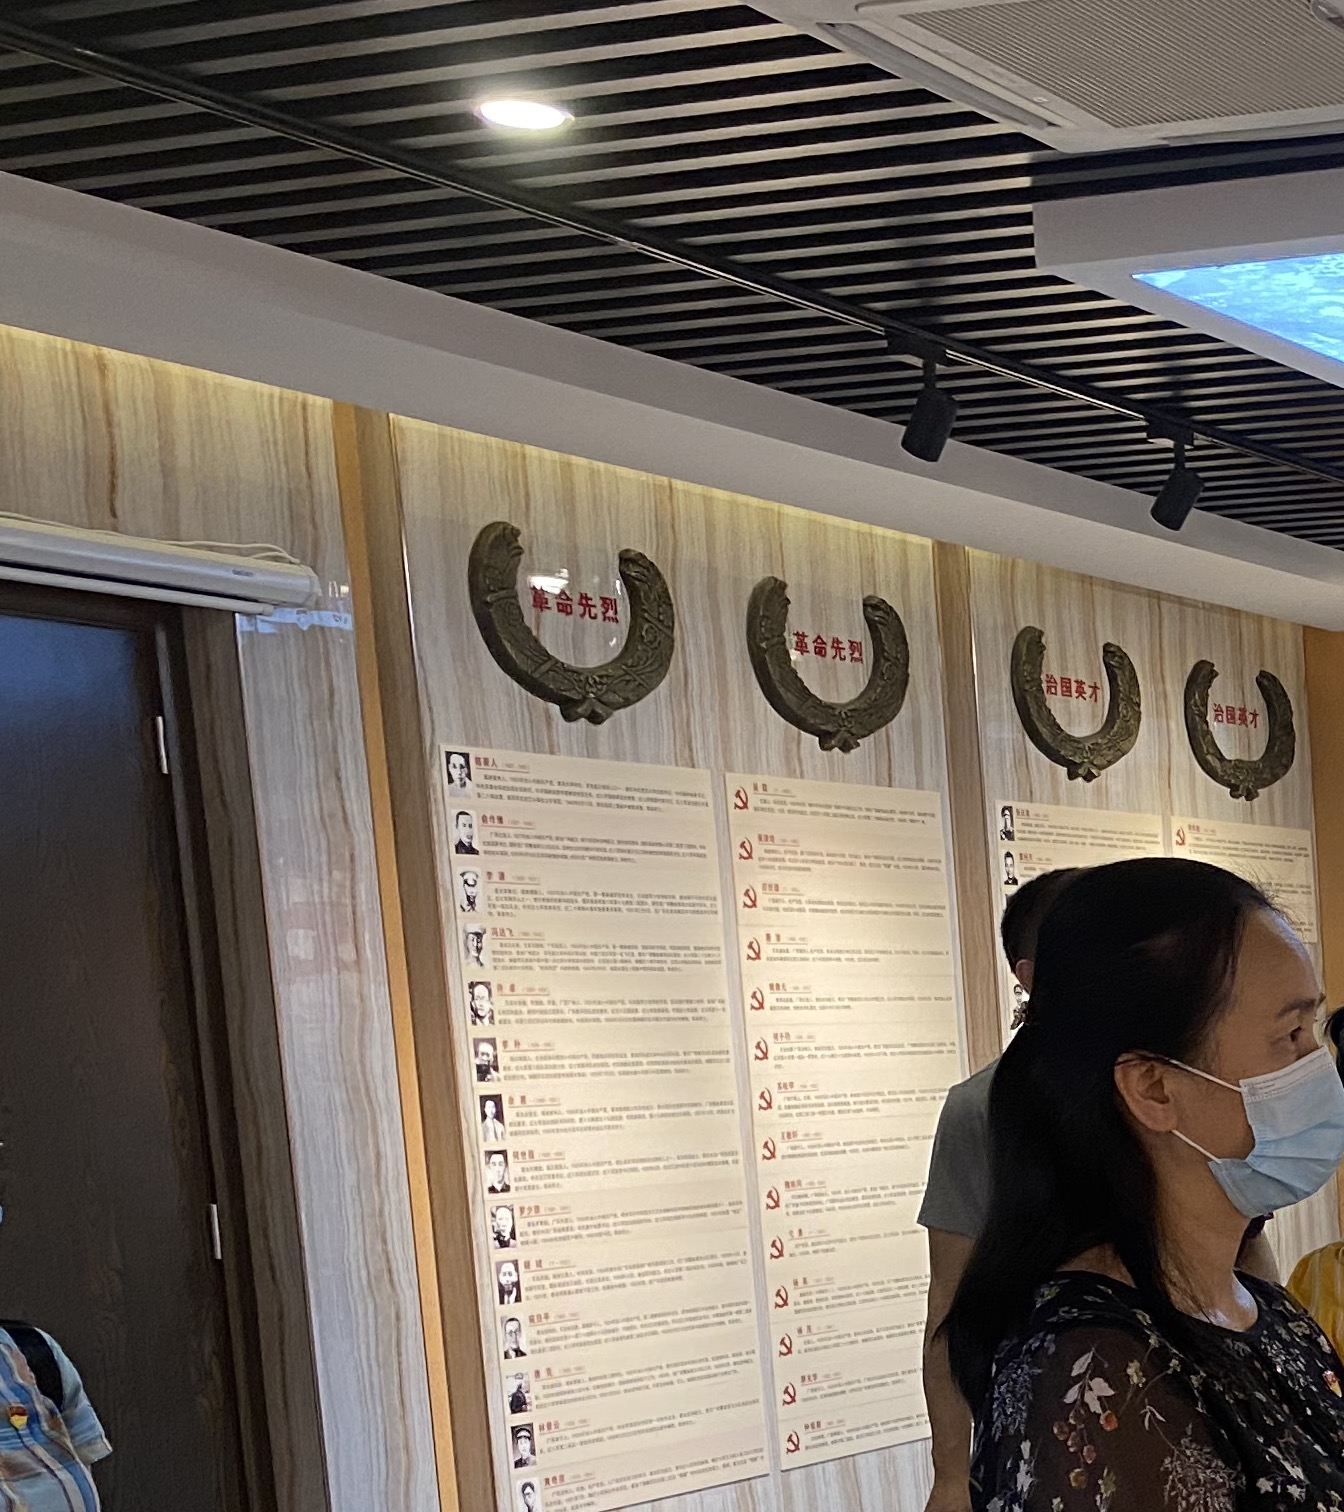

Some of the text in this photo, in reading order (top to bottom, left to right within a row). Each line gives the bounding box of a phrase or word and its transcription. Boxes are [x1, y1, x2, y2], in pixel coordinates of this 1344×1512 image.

[530, 586, 620, 624] 革命先烈
[793, 630, 864, 664] 革命先烈
[1044, 673, 1101, 703] 治国英才
[1213, 702, 1260, 729] 治国英才
